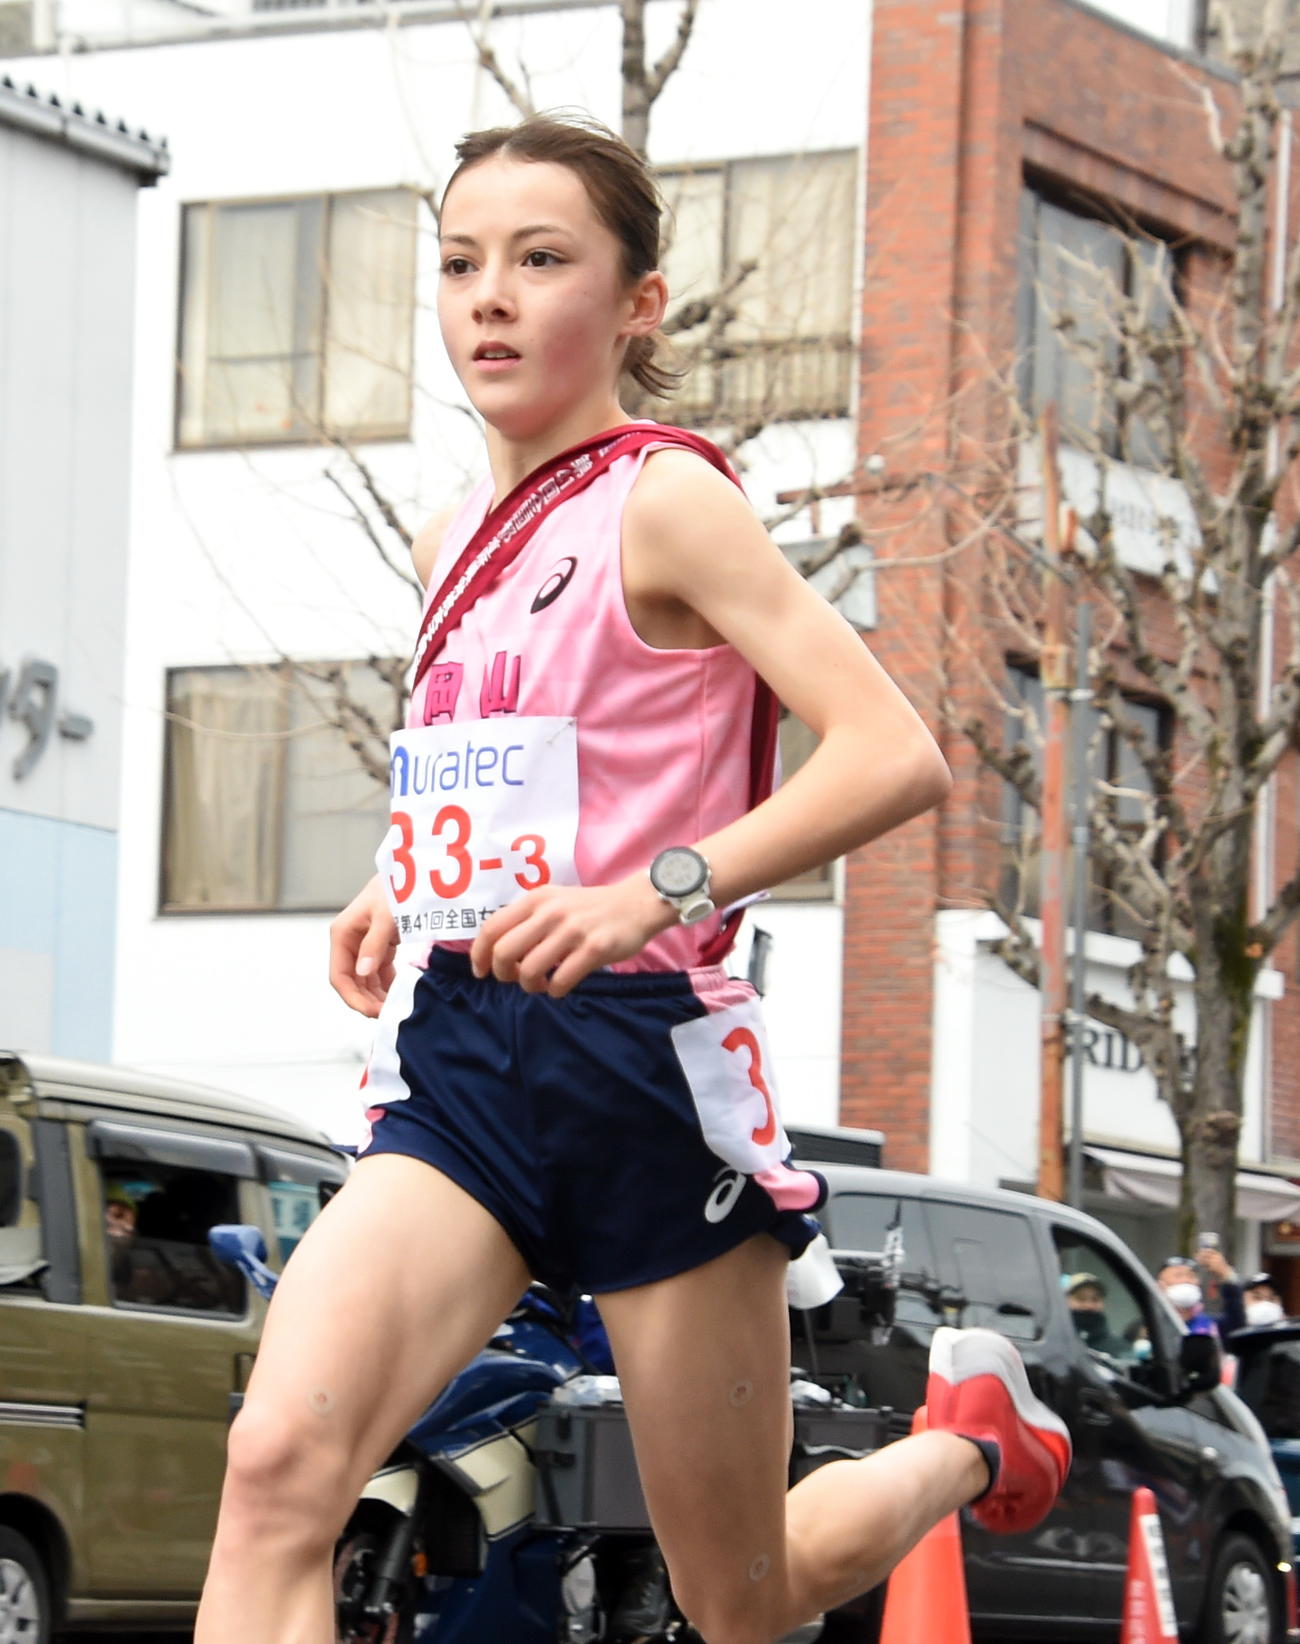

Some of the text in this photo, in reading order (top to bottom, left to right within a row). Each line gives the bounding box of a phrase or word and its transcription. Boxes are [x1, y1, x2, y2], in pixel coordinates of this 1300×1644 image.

[0, 659, 94, 782] ター
[423, 650, 521, 727] 岡山
[390, 804, 551, 904] 33-3
[721, 1026, 776, 1147] 3
